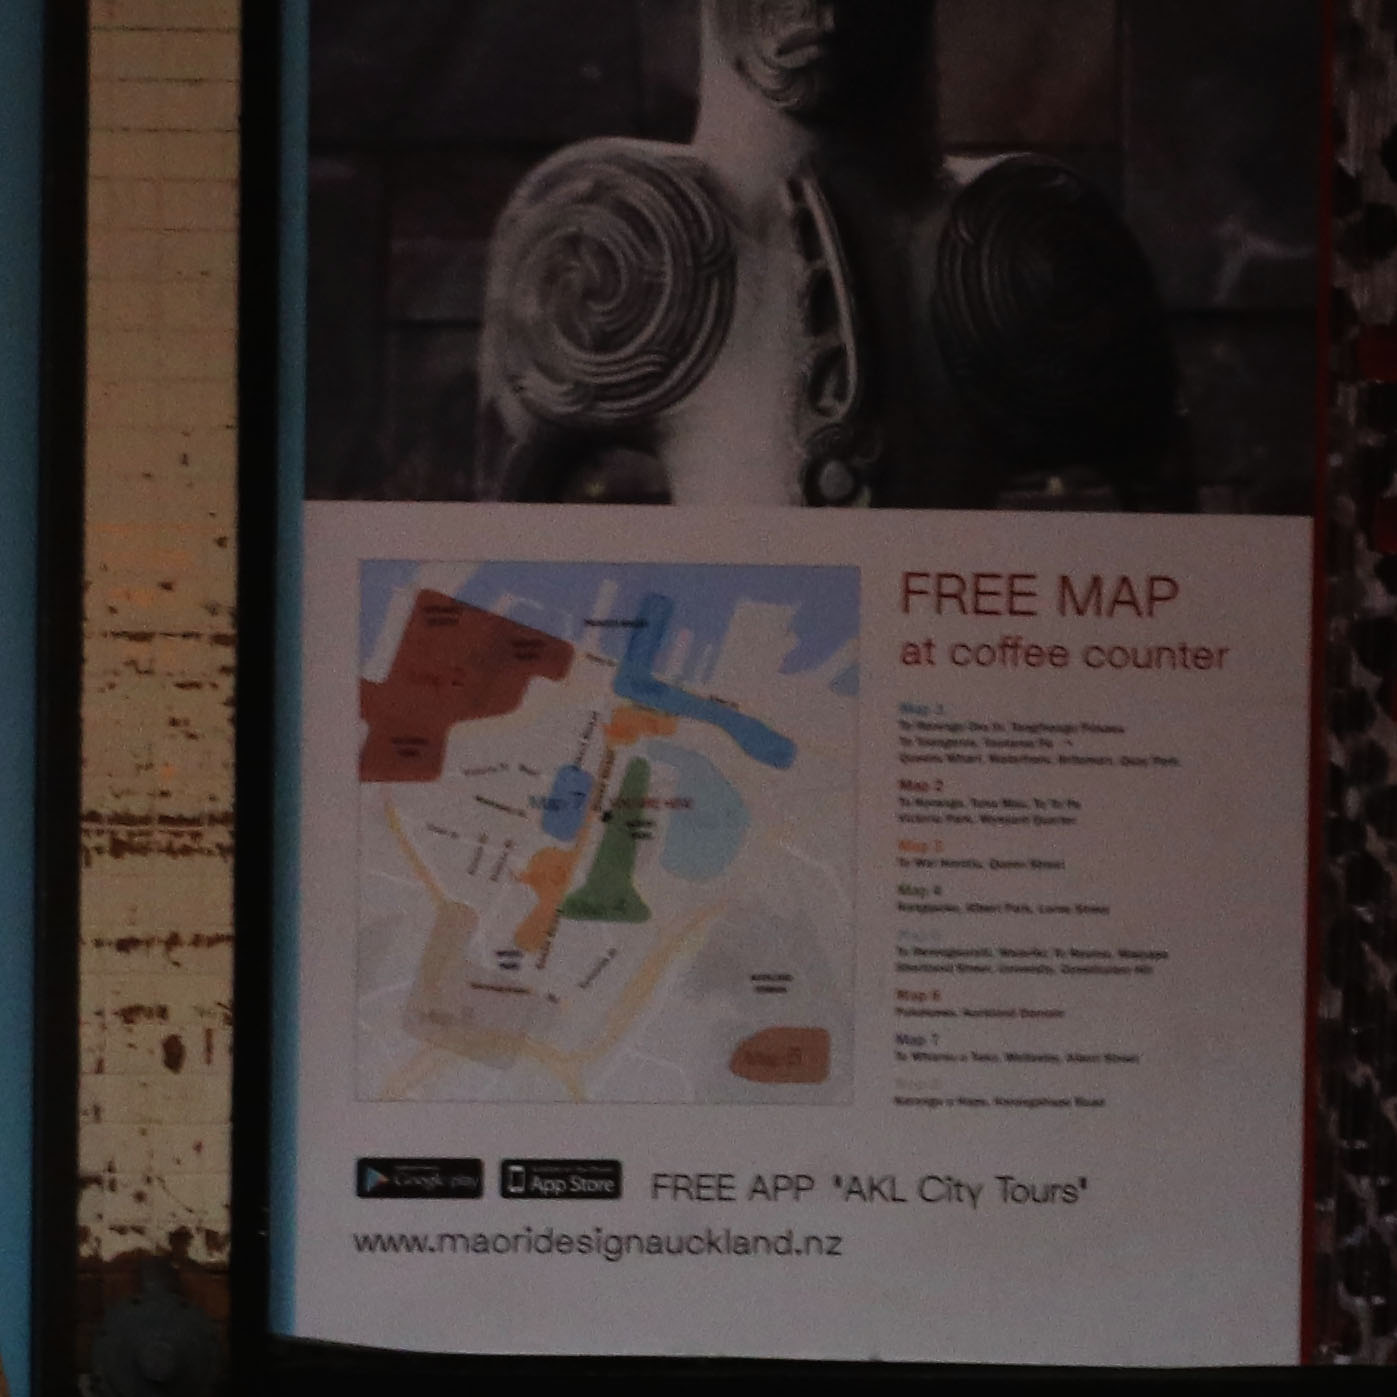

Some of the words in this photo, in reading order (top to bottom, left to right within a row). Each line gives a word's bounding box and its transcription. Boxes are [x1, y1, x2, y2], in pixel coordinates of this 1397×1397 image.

[901, 571, 1039, 616] FREE
[1056, 573, 1180, 618] MAP
[901, 637, 936, 667] at
[950, 635, 1070, 668] coffee
[1083, 641, 1231, 671] counter
[530, 1176, 566, 1195] App
[569, 1175, 616, 1193] Store
[651, 1173, 737, 1202] FREE
[748, 1174, 815, 1202] APP
[917, 1173, 985, 1210] City
[352, 1225, 843, 1262] www.maoridesignauckland.nz
